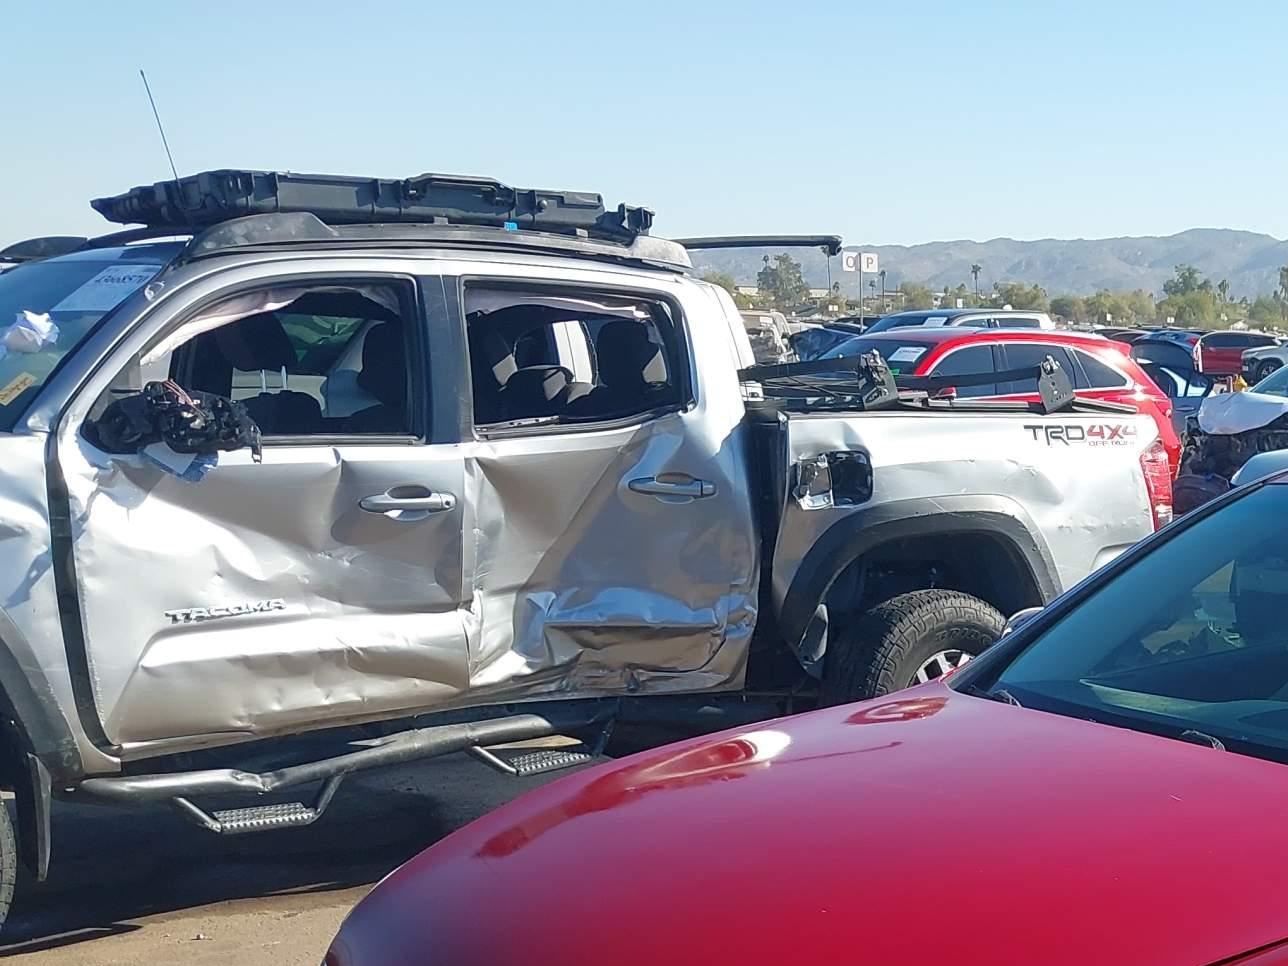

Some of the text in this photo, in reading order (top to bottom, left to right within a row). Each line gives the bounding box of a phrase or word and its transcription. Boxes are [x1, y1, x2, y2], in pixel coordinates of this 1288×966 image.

[866, 256, 874, 269] P
[1023, 424, 1085, 446] TRD
[163, 598, 287, 624] TACOMA
